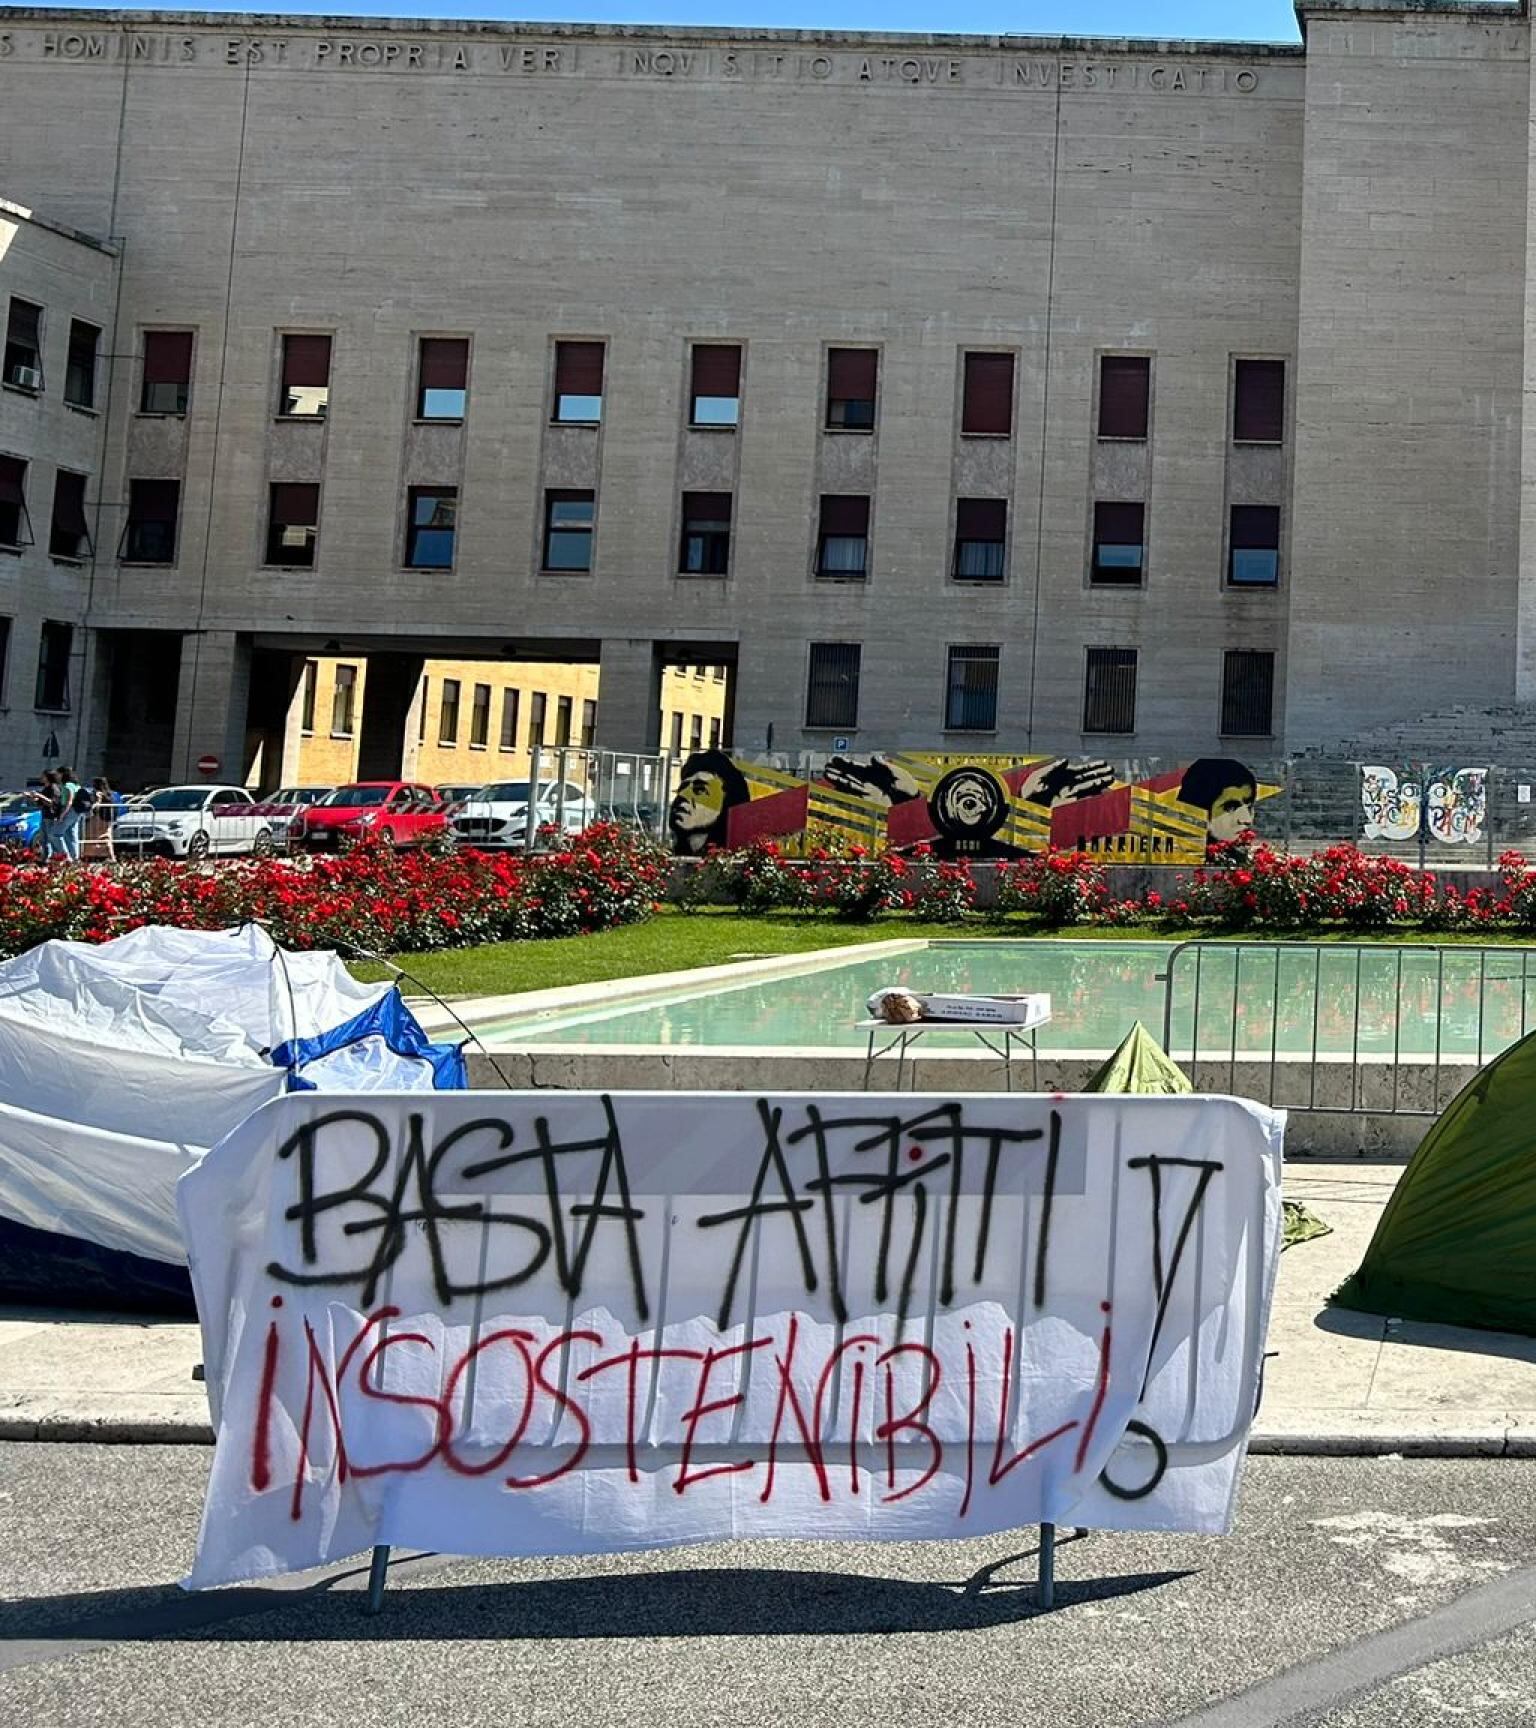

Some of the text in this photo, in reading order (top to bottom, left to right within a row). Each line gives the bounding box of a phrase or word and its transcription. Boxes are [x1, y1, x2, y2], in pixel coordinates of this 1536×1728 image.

[44, 34, 194, 61] HOMINIS
[226, 39, 289, 65] EST
[315, 41, 468, 70] PROPRIA
[500, 47, 578, 73] VERI
[857, 56, 961, 84] ATQVE
[996, 62, 1259, 93] INVESTIGATIO
[266, 1094, 653, 1323] BASTA
